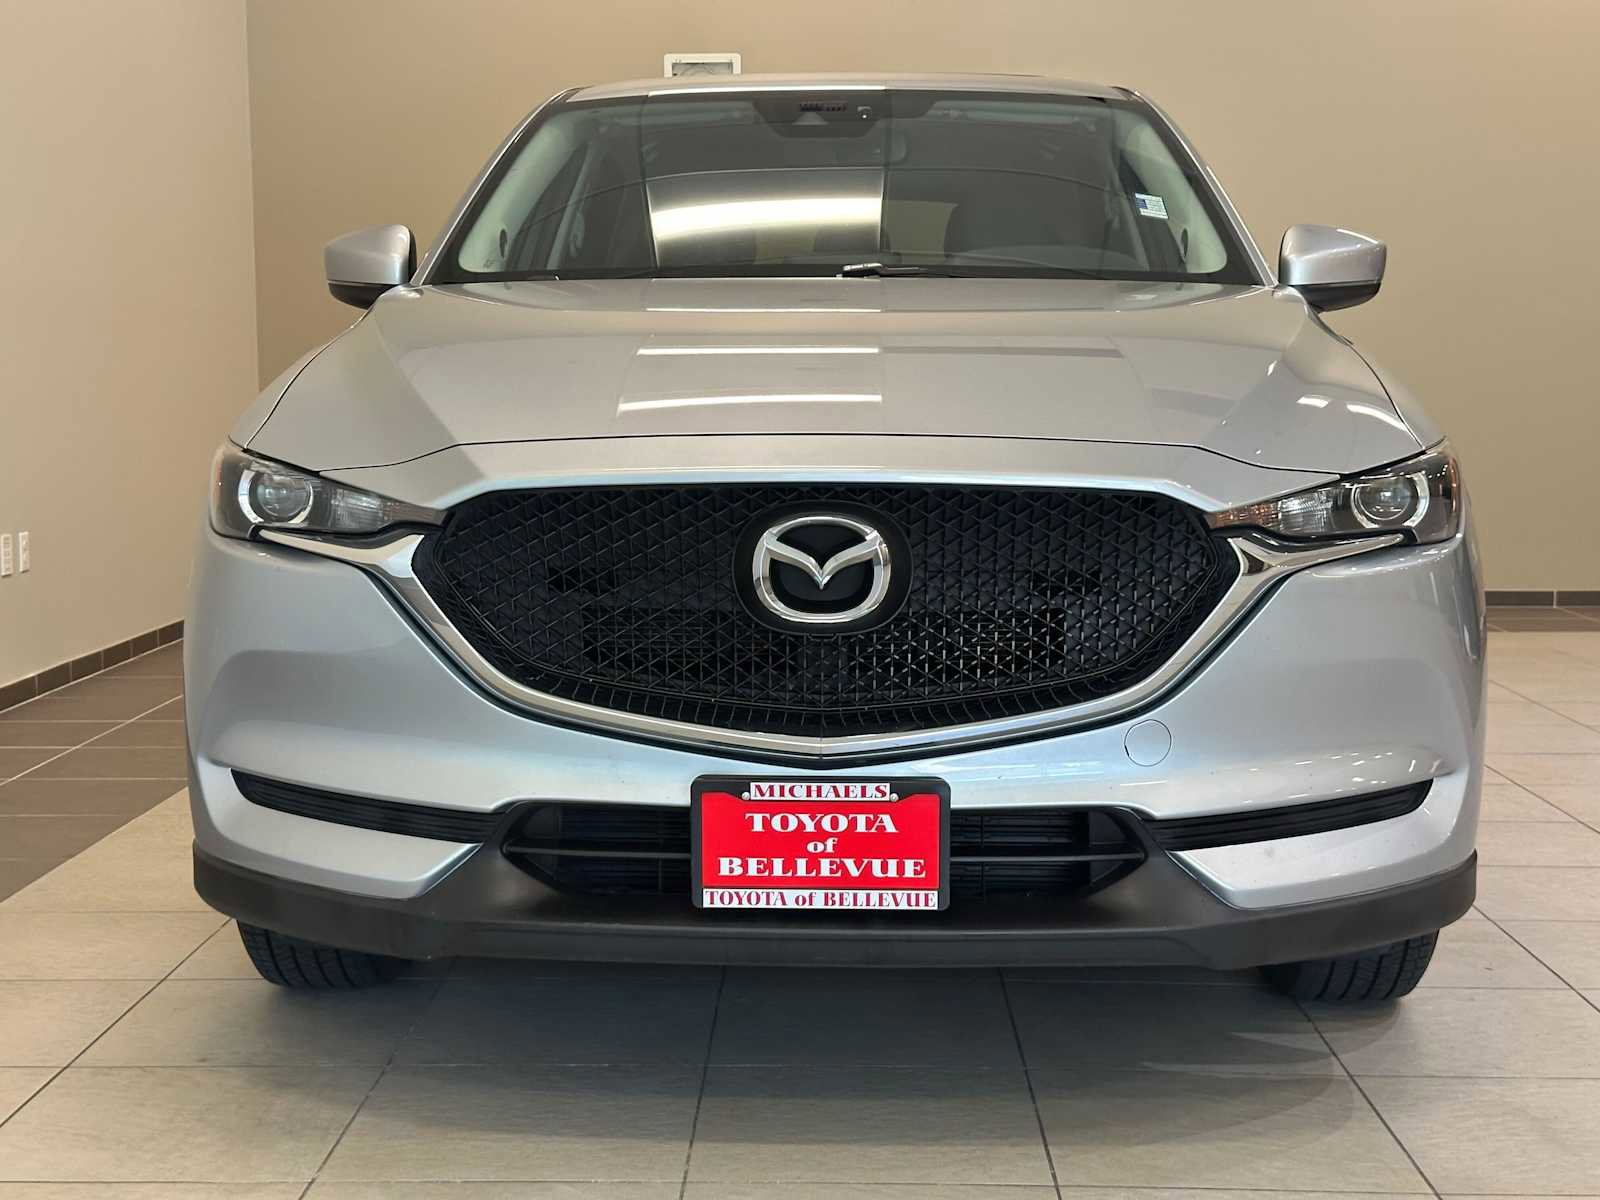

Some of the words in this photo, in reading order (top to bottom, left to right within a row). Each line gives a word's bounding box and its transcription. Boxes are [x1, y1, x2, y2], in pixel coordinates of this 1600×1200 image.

[754, 784, 888, 799] MICHAELS
[745, 813, 898, 833] TOYOTA
[806, 837, 838, 854] of
[718, 857, 927, 878] BELLEVUE
[705, 890, 787, 906] TOYOTA
[794, 891, 817, 907] of
[824, 891, 937, 908] BELLEVUE
